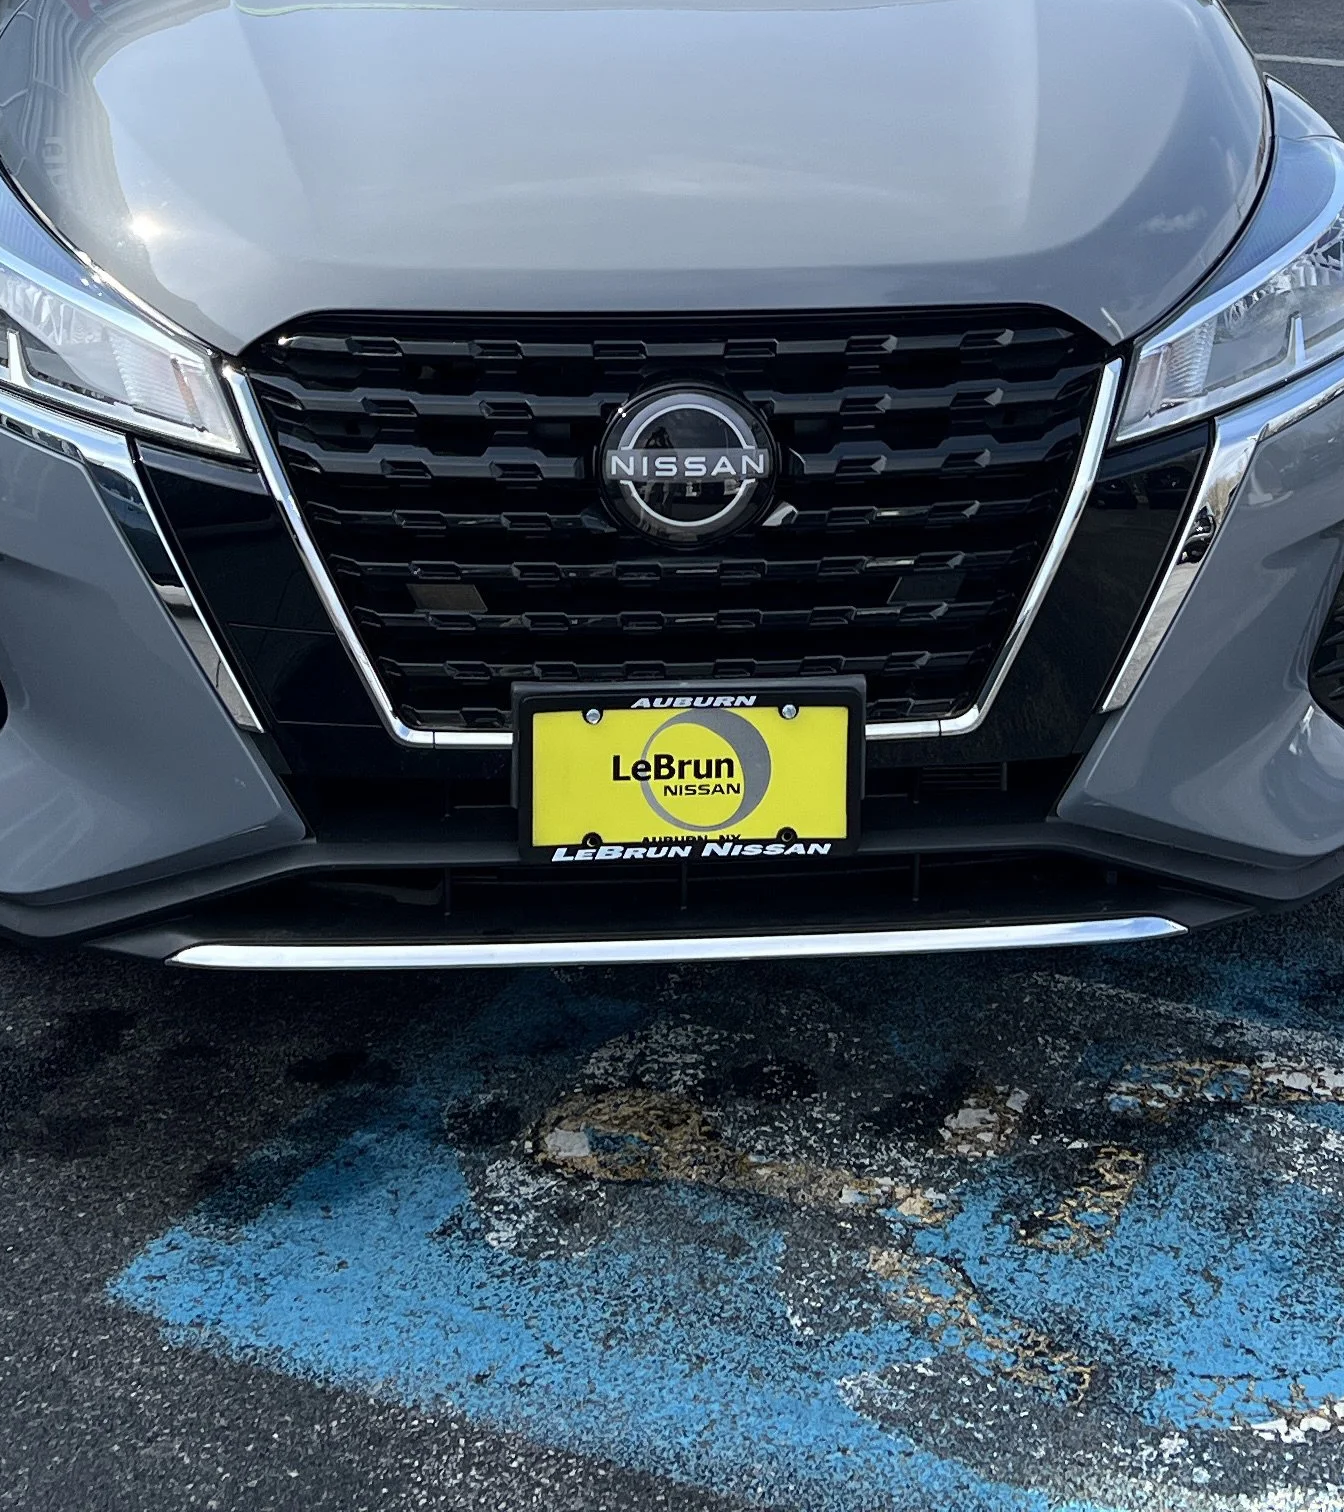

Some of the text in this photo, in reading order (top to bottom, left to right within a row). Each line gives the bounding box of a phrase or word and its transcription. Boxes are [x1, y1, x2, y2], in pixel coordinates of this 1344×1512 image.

[610, 453, 765, 477] NISSAN
[630, 695, 757, 708] AUBURN
[612, 753, 735, 782] LeBrun
[662, 783, 742, 797] NISSAN
